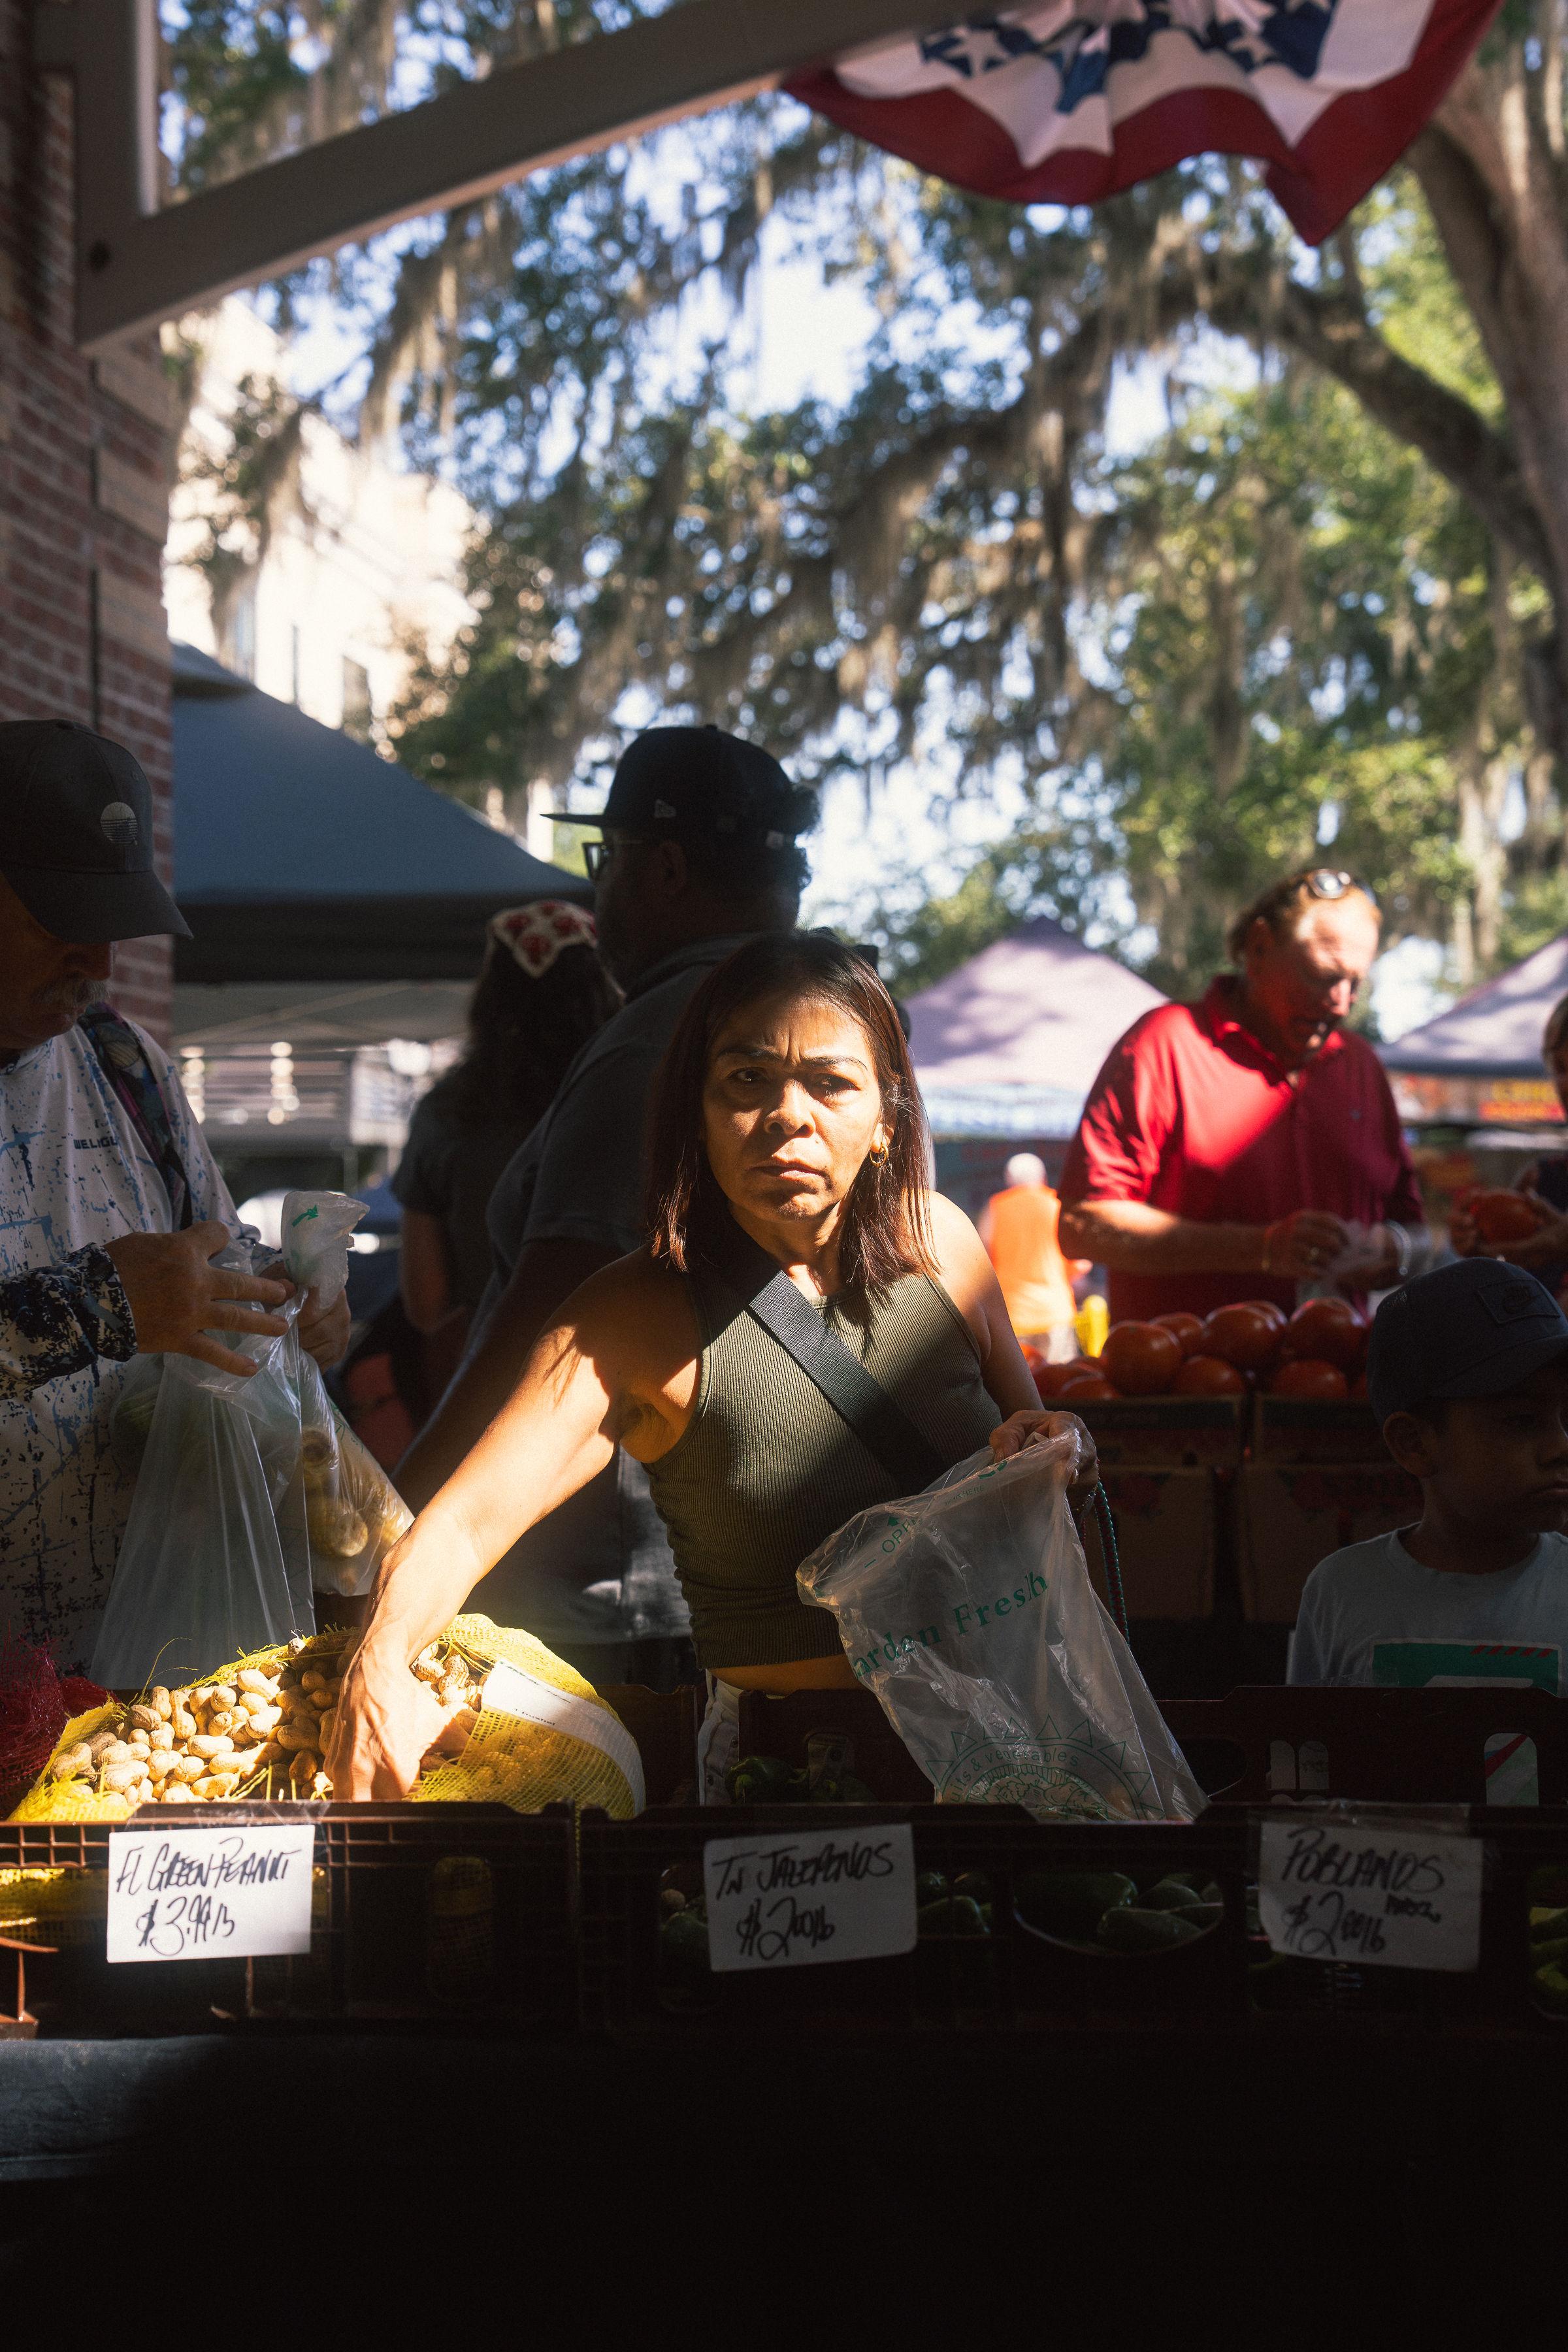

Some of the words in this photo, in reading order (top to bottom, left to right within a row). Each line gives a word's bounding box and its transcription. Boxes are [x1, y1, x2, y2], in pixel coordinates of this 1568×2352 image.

[854, 1625, 942, 1678] arden
[953, 1571, 1048, 1635] Fresh
[951, 1771, 972, 1803] uits
[985, 1748, 1079, 1767] vegetables
[148, 1843, 214, 1891] GREEN
[1282, 1827, 1445, 1893] POBLANOS
